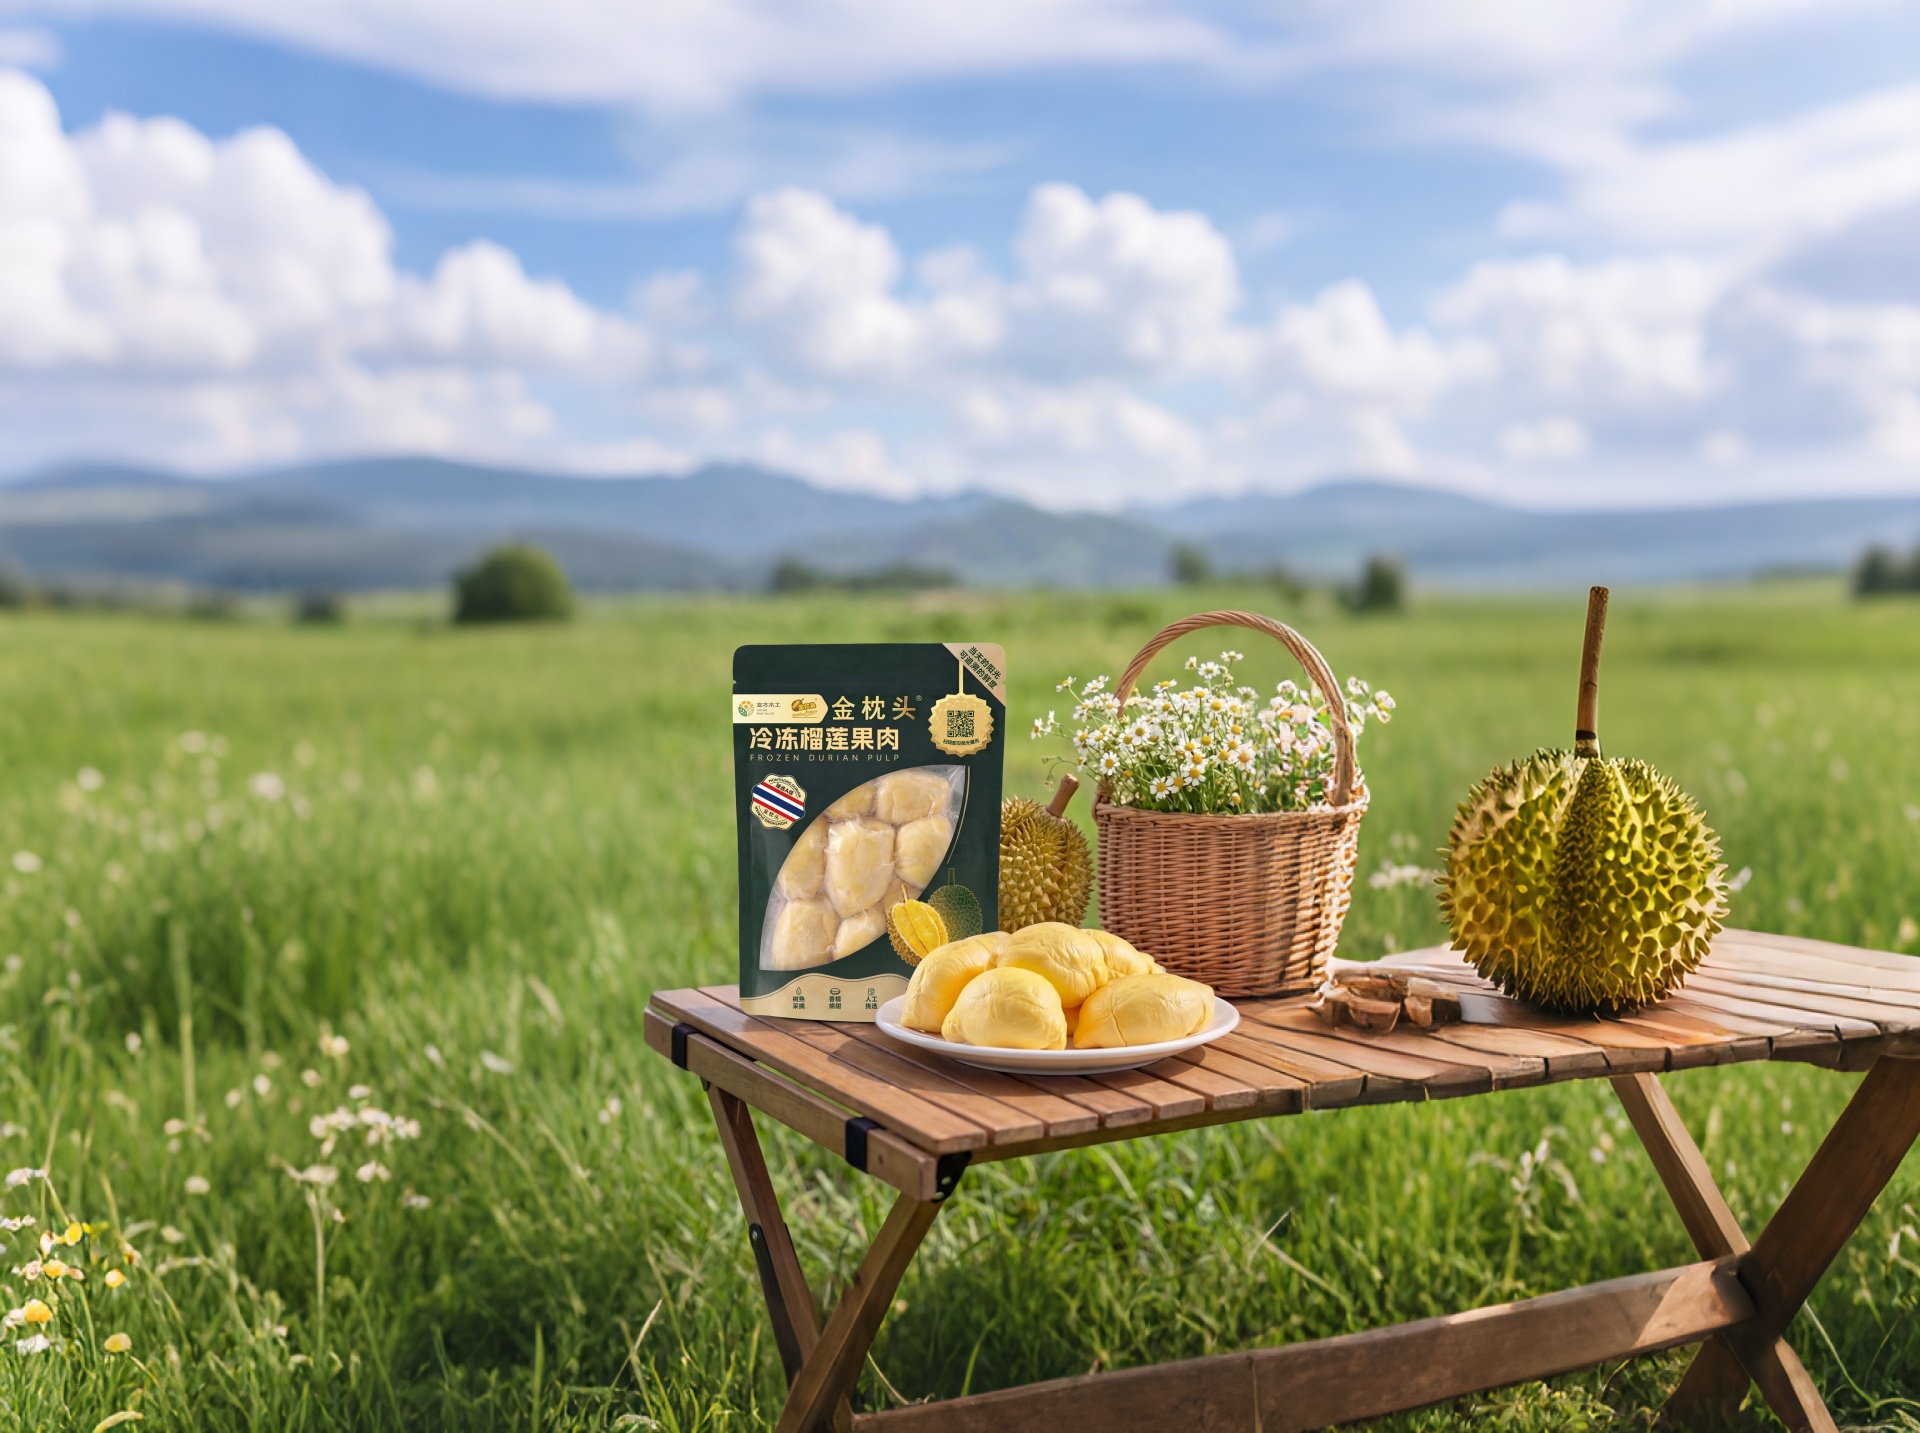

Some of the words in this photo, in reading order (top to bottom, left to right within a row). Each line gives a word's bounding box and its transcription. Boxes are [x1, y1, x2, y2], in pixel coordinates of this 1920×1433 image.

[960, 650, 998, 689] 可追溯的鲜度
[968, 646, 1001, 680] 当天的阳光
[832, 696, 916, 721] 金枕头
[749, 727, 899, 751] 冷冻榴莲果肉
[750, 754, 800, 762] FROZEN
[808, 754, 859, 762] DURIAN
[868, 754, 900, 762] PULP
